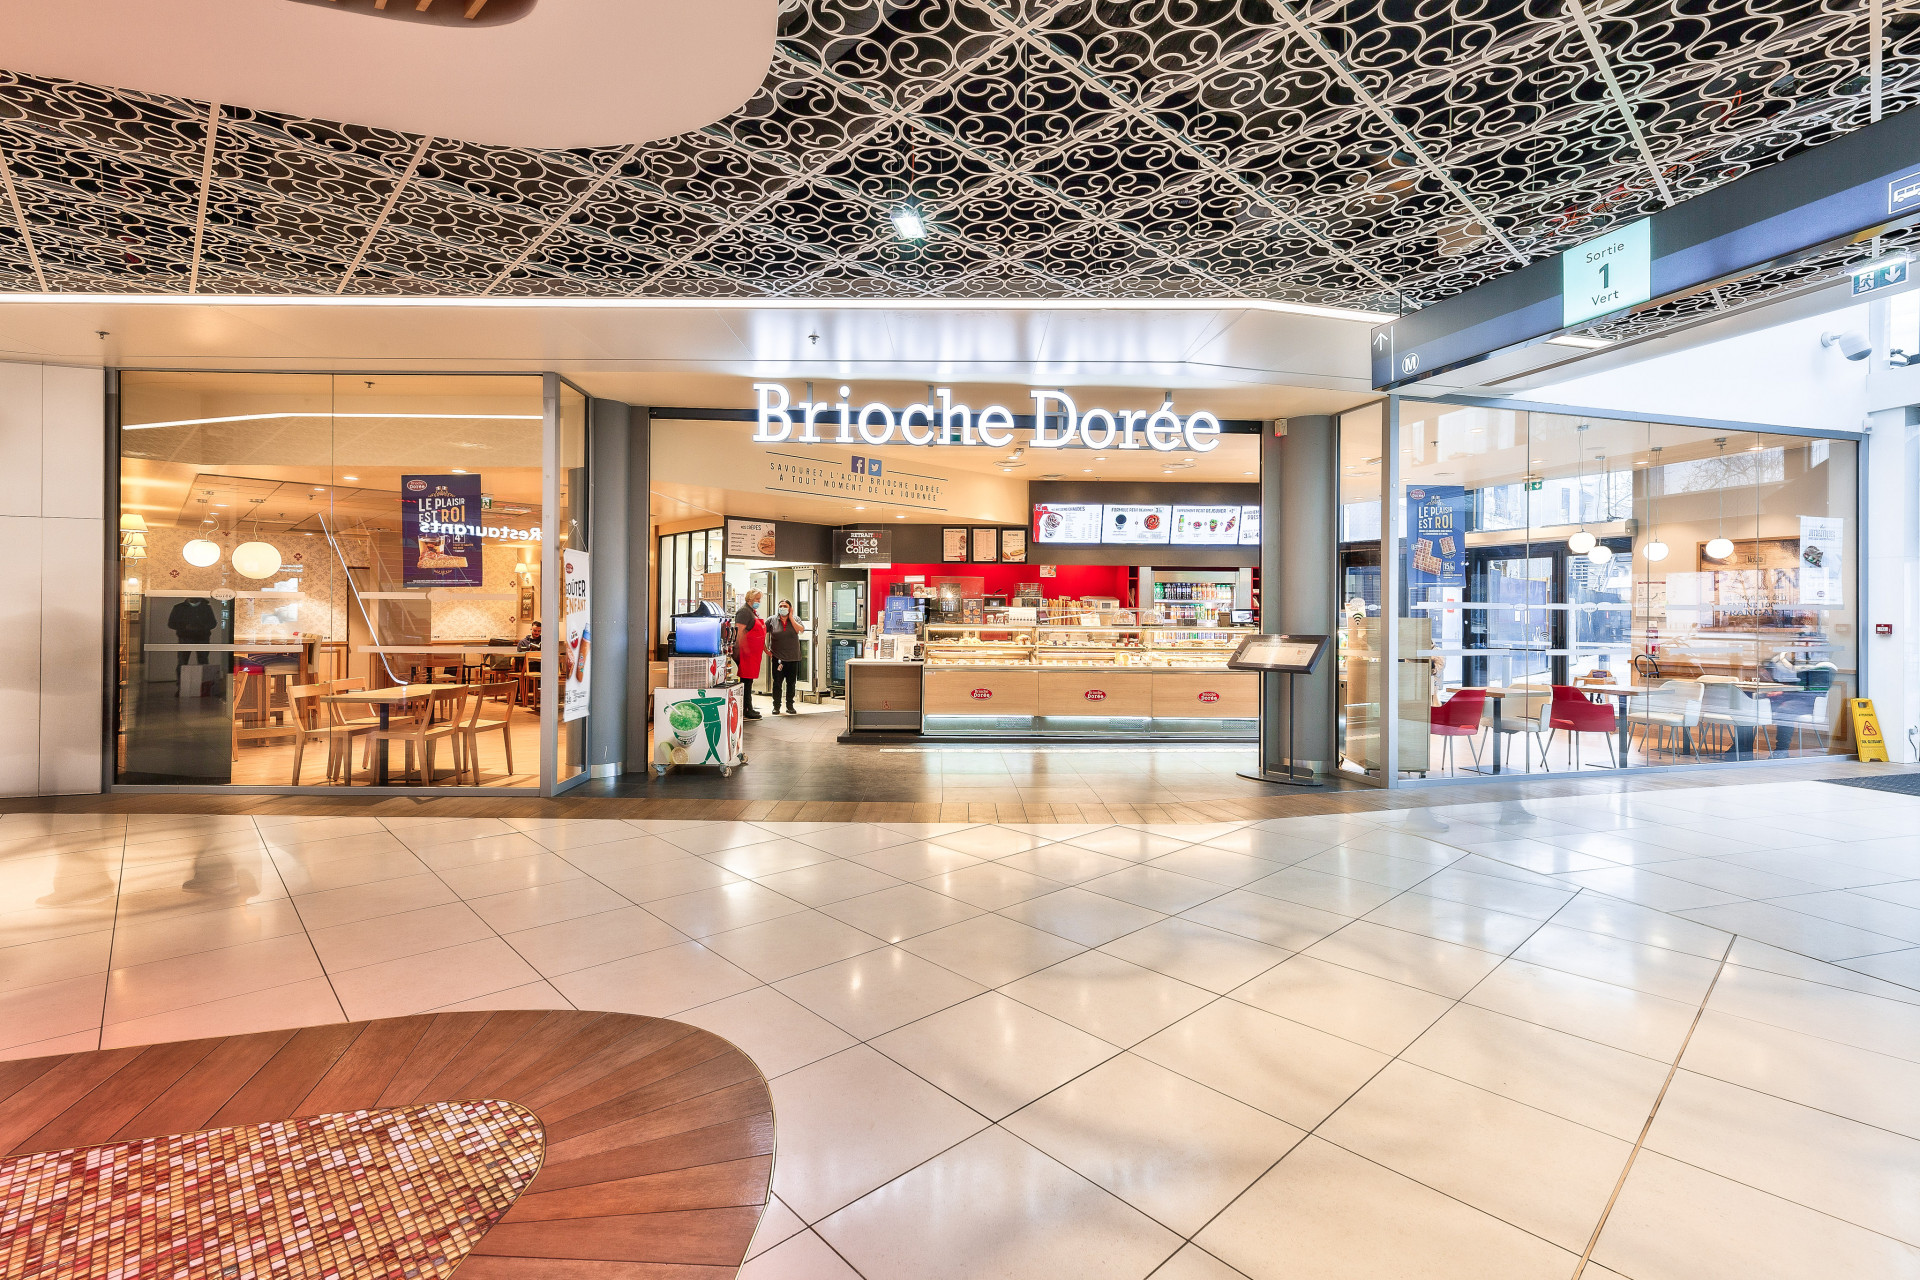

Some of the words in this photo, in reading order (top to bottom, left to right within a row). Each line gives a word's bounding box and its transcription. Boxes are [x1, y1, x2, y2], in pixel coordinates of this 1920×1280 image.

[1586, 243, 1624, 264] Sortie
[1598, 263, 1609, 289] 1
[1592, 290, 1619, 306] Vert
[752, 382, 1014, 448] Brioche
[1028, 390, 1222, 452] Dorée
[770, 462, 823, 478] SAVOUREZ
[830, 471, 864, 482] L'ACTU
[870, 478, 908, 490] BRIOCHE
[792, 475, 816, 486] TOUT
[824, 480, 862, 492] MOMENT
[900, 490, 936, 502] JOURNÉE
[419, 498, 432, 512] LE
[435, 498, 465, 510] PLAISIR
[419, 510, 437, 522] EST
[441, 505, 465, 522] ROI
[1419, 506, 1428, 518] LE
[1430, 506, 1452, 516] PLAISIR
[1419, 518, 1432, 528] EST
[1435, 513, 1453, 528] ROI
[846, 538, 869, 546] Click
[566, 597, 586, 615] ENFANT
